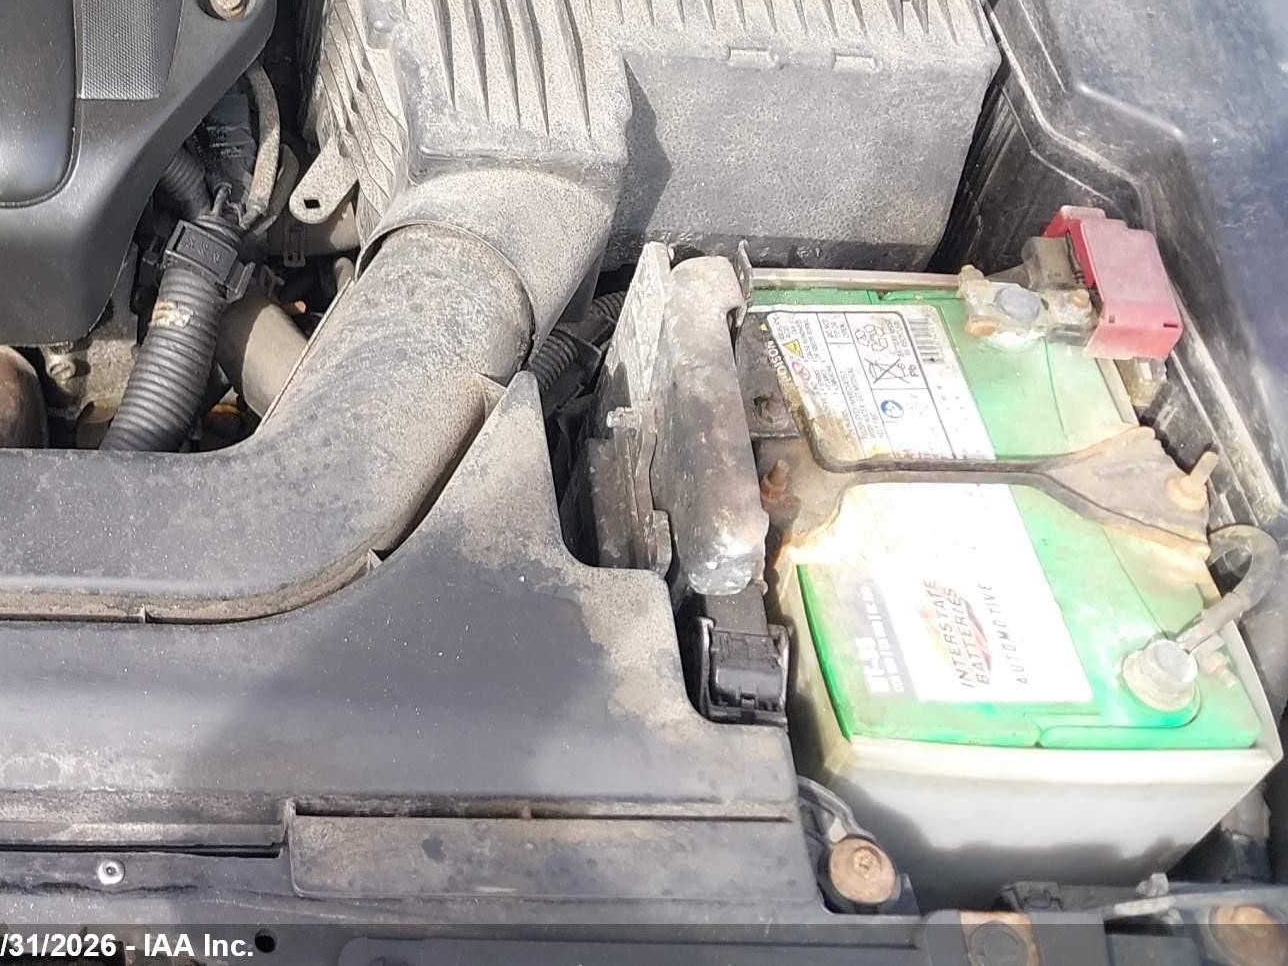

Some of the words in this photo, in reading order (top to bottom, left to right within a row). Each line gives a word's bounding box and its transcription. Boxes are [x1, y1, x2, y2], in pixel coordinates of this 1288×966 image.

[905, 363, 920, 377] Pb
[923, 579, 975, 689] INTERSTATE
[943, 587, 991, 685] BATTERIES
[977, 583, 1029, 685] AUTOMOTIVE
